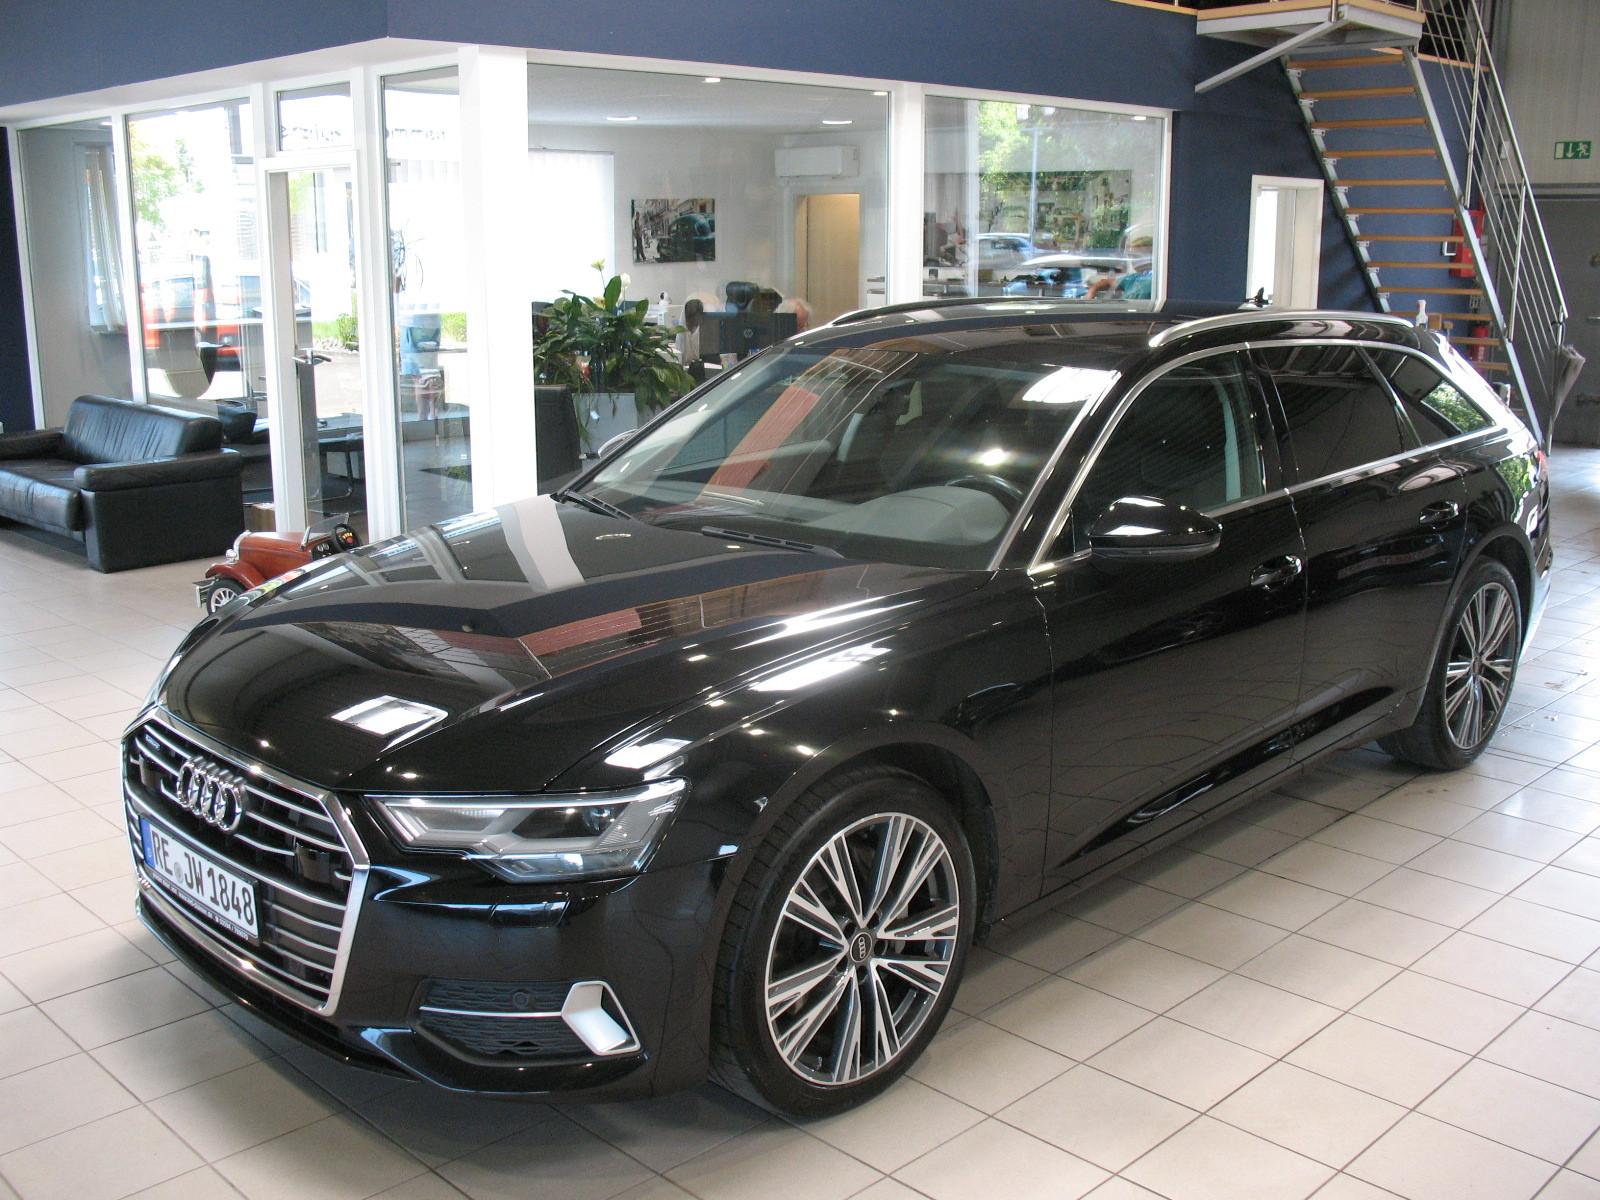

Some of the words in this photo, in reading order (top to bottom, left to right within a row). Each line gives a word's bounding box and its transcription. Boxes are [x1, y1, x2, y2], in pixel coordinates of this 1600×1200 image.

[151, 830, 173, 876] RE
[184, 851, 205, 897] JW
[207, 867, 255, 926] 1848
